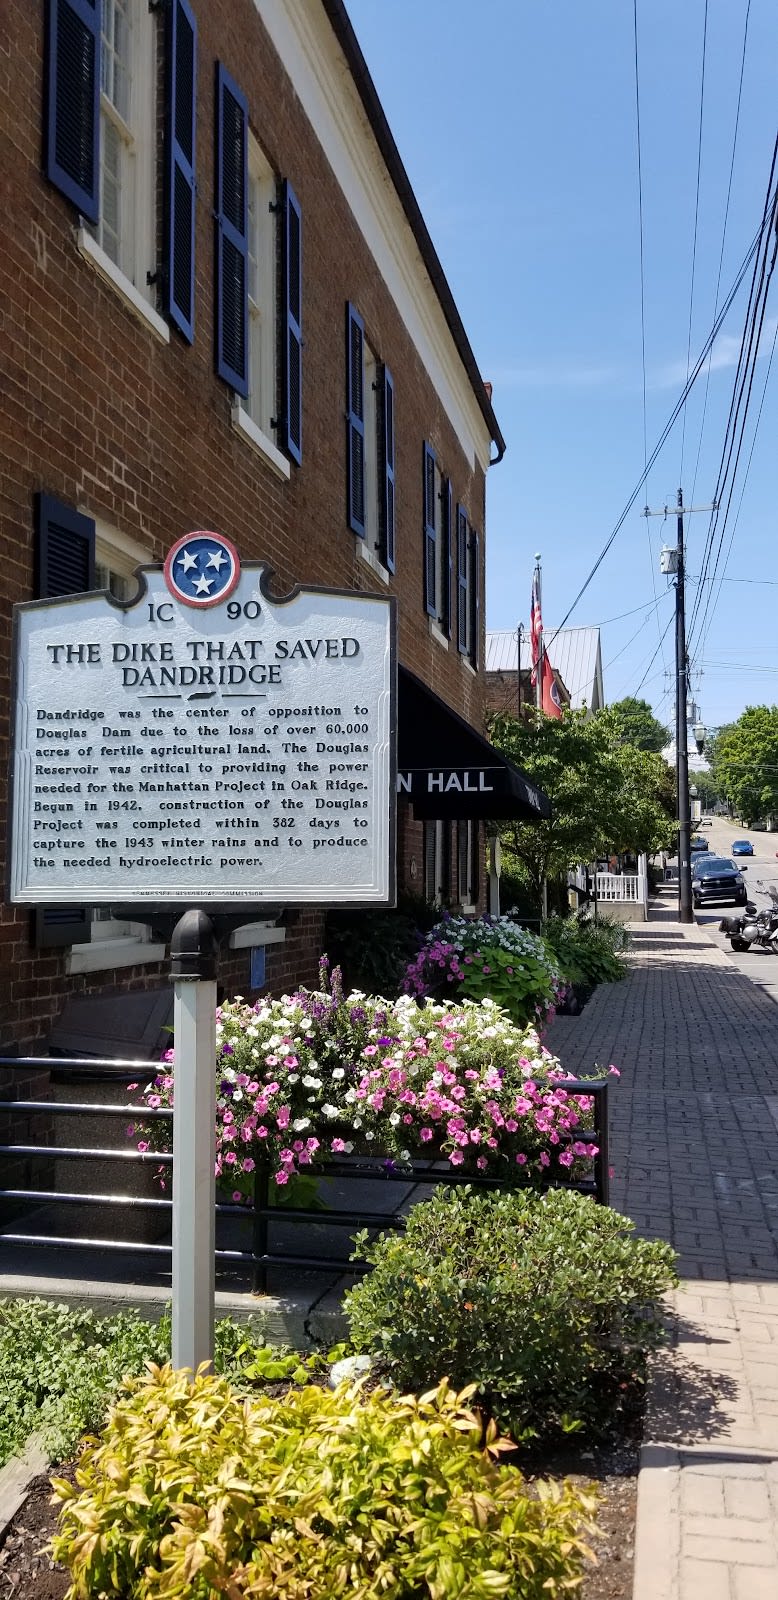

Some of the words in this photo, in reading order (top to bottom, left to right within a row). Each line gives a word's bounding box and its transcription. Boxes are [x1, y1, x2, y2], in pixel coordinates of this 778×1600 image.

[226, 600, 262, 620] 90
[47, 644, 101, 664] THE
[112, 643, 173, 662] DIKE
[187, 641, 262, 660] THAT
[275, 638, 360, 659] SAVED
[122, 665, 282, 686] DANDRIDGE
[37, 708, 105, 721] Dandridge
[119, 710, 141, 718] was
[152, 707, 175, 718] the
[186, 706, 230, 718] center
[241, 706, 257, 717] of
[269, 705, 342, 718] opposition
[354, 704, 369, 715] to
[37, 727, 88, 740] Douglas
[103, 726, 132, 737] Dam
[140, 726, 164, 736] due
[173, 725, 188, 736] to
[197, 725, 220, 736] the
[229, 724, 254, 735] loss
[264, 724, 279, 735] of
[287, 726, 317, 734] over
[36, 748, 70, 757] acres
[78, 746, 93, 756] of
[101, 744, 144, 756] fertile
[151, 743, 231, 758] agricultural
[238, 743, 271, 754] land.
[282, 742, 308, 753] The
[316, 742, 369, 755] Douglas
[35, 765, 99, 775] Reservoir
[109, 766, 131, 774] was
[141, 762, 190, 773] critical
[198, 762, 213, 772] to
[222, 761, 287, 775] providing
[297, 761, 320, 772] the
[329, 763, 369, 774] power
[35, 782, 82, 793] needed
[87, 782, 108, 792] for
[112, 781, 134, 792] the
[139, 781, 210, 792] Manhattan
[215, 780, 266, 793] Project
[272, 780, 286, 790] in
[291, 779, 319, 790] Oak
[326, 779, 369, 792] Ridge.
[427, 771, 494, 792] HALL
[34, 801, 74, 814] Begun
[85, 800, 98, 811] in
[159, 799, 245, 810] construction
[255, 798, 271, 809] of
[281, 798, 304, 808] the
[316, 797, 369, 810] Douglas
[34, 819, 84, 832] Project
[96, 821, 119, 829] was
[133, 817, 201, 831] completed
[216, 817, 260, 828] within
[273, 817, 296, 828] 382
[309, 817, 340, 830] days
[353, 817, 369, 827] to
[33, 838, 86, 851] capture
[95, 837, 118, 848] the
[126, 837, 154, 848] 1943
[162, 837, 205, 847] winter
[212, 836, 247, 847] rains
[254, 836, 280, 847] and
[288, 836, 304, 847] to
[313, 835, 369, 849] produce
[33, 856, 56, 867] the
[63, 856, 112, 867] needed
[119, 855, 213, 869] hydroelectric
[220, 858, 264, 868] power.
